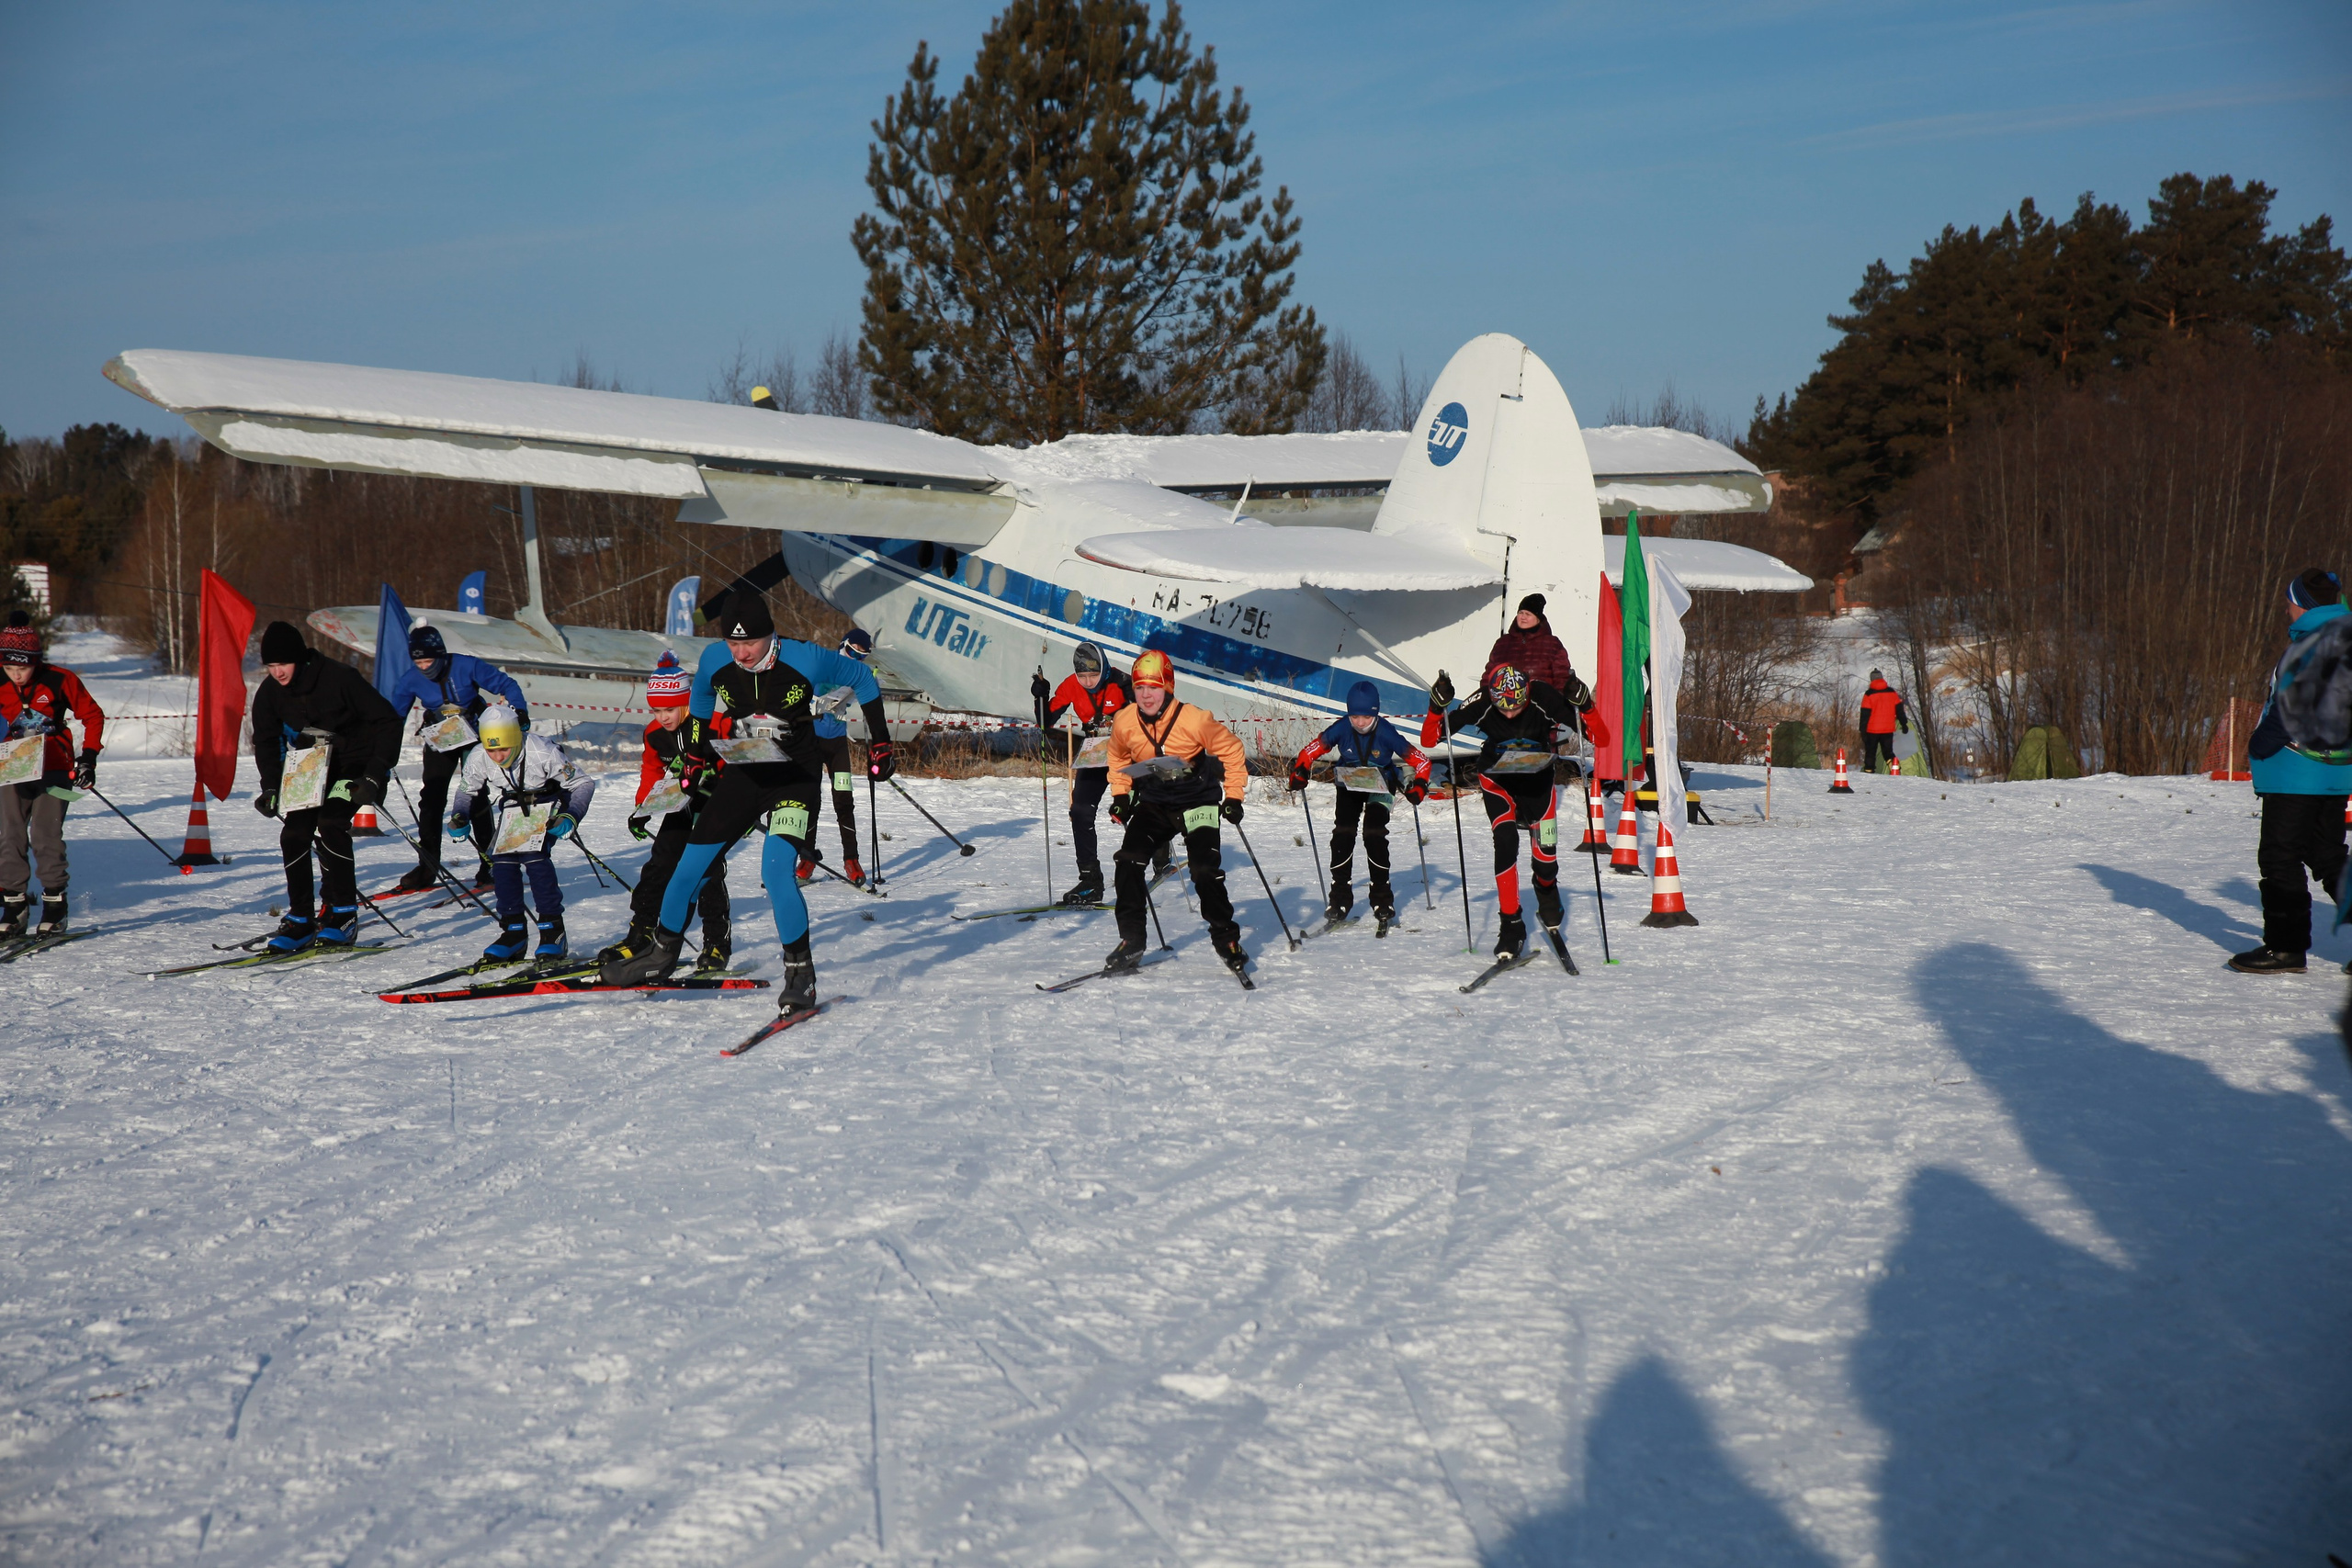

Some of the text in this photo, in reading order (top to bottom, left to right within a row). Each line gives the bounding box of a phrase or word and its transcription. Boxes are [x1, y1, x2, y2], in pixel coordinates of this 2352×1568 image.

[904, 596, 992, 660] UTair
[648, 681, 681, 690] USSIA
[775, 817, 802, 829] 403.1
[1189, 812, 1213, 825] 402.1
[315, 946, 354, 956] FISCHER
[478, 960, 533, 973] FISCHER
